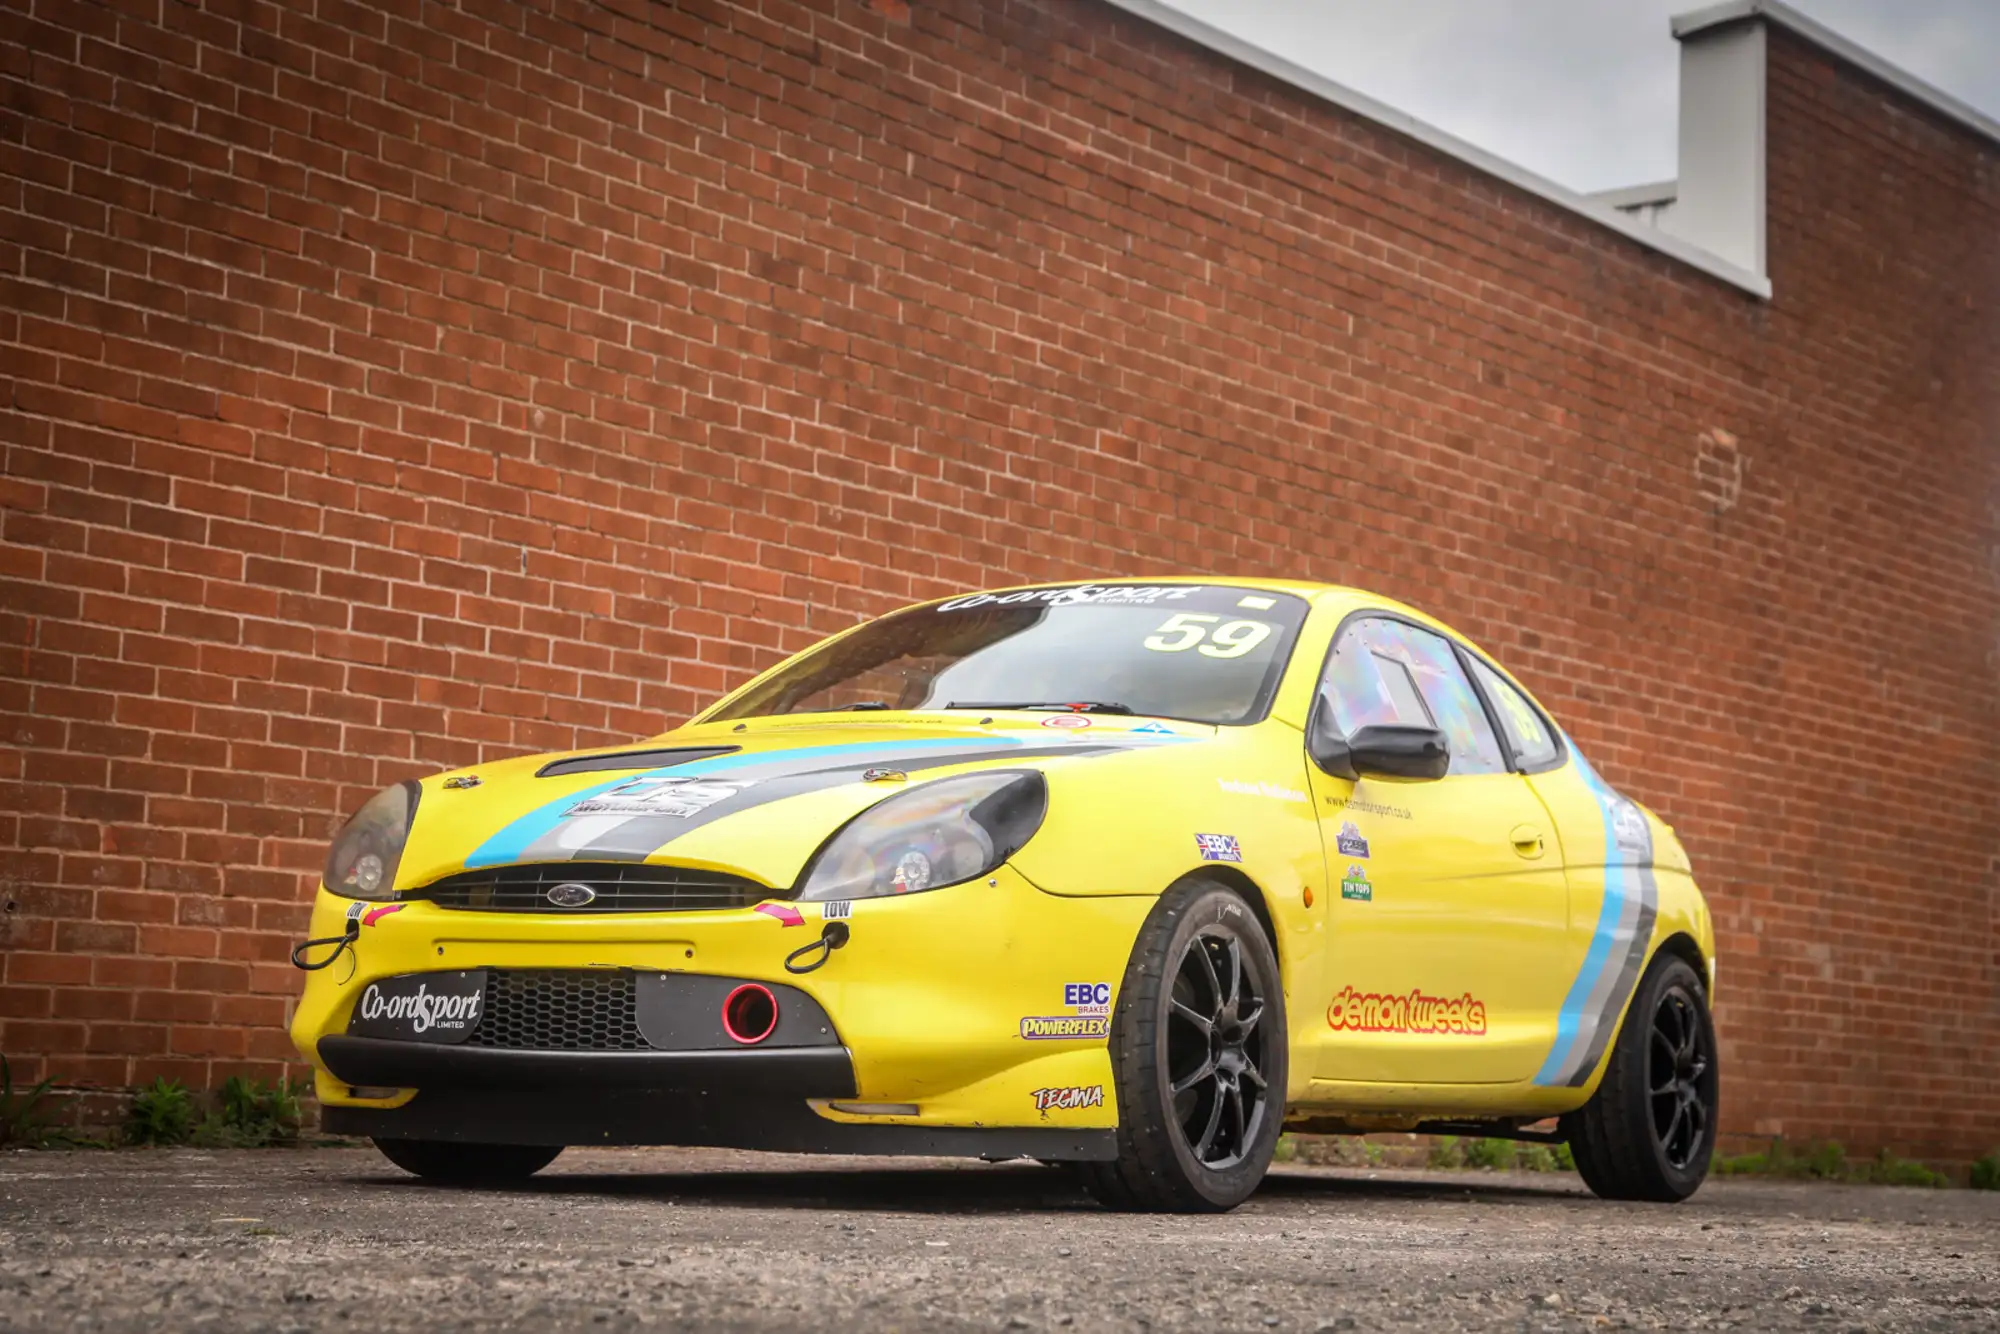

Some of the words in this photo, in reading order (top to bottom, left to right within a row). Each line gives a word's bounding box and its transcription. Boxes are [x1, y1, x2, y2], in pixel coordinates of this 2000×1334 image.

[1143, 613, 1271, 659] 59
[1204, 834, 1233, 853] EBC
[1343, 881, 1355, 893] TIN
[824, 902, 850, 918] TOW
[1064, 984, 1110, 1005] EBC
[1077, 1005, 1110, 1014] BRAKES
[437, 1020, 465, 1029] LIMITED
[1023, 1018, 1108, 1037] POWERFLEX
[1031, 1085, 1104, 1110] TEGIWA
